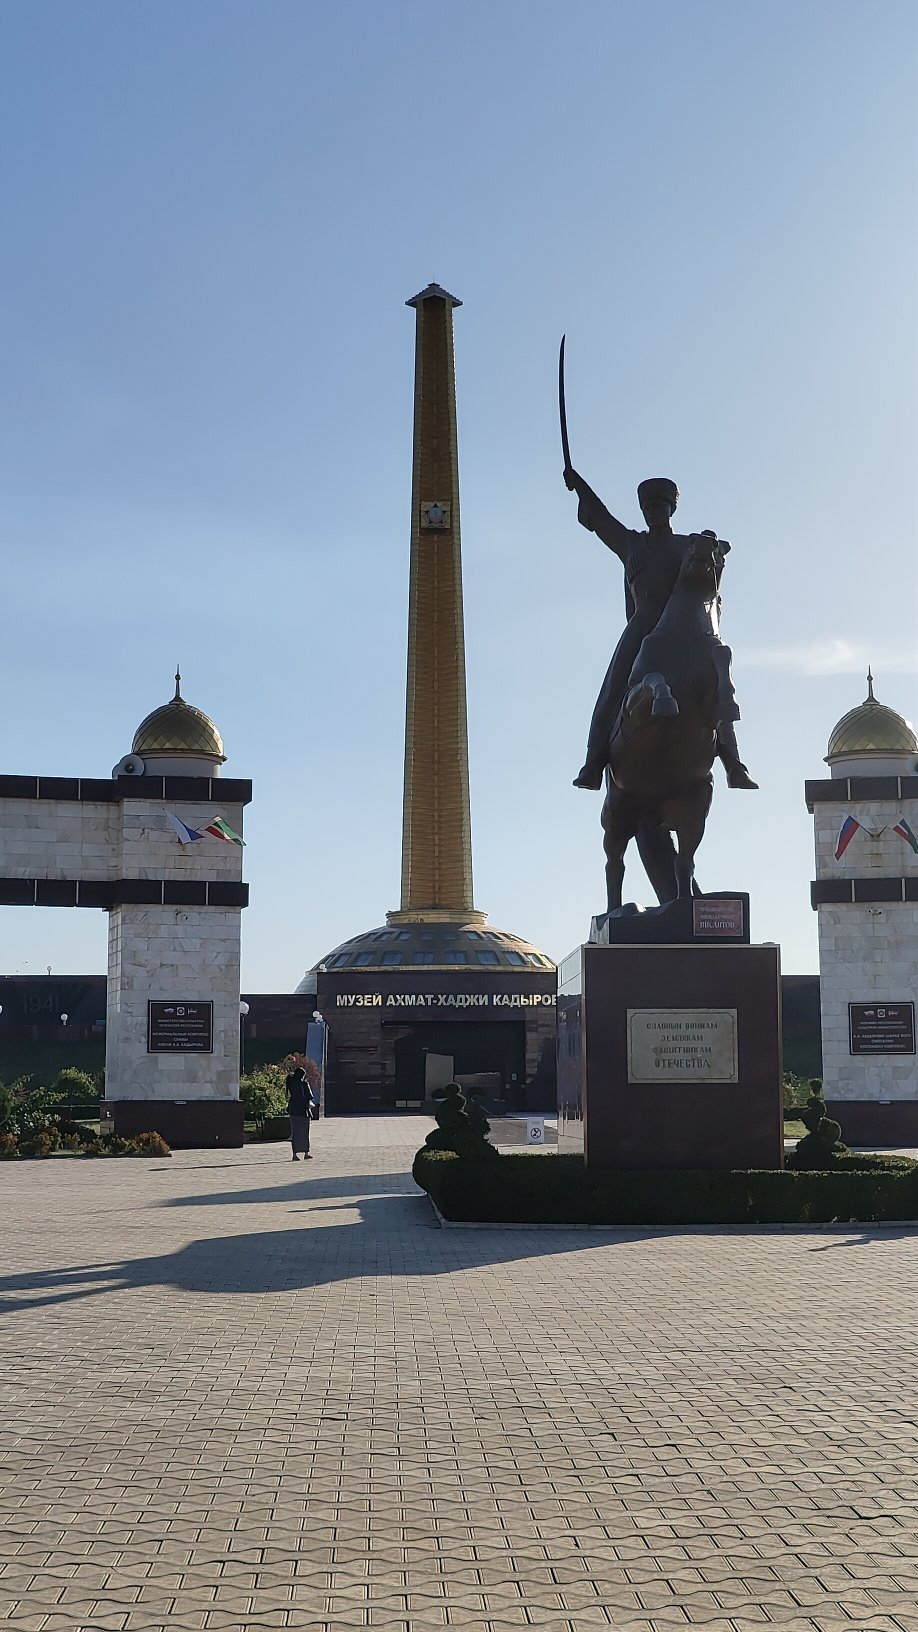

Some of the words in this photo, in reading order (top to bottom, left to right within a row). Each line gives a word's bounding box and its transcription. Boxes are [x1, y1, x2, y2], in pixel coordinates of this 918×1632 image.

[336, 992, 382, 1006] МУЗЕЙ
[386, 994, 489, 1008] АХМАТ-ХАДЖИ
[685, 1022, 718, 1030] ВОИНАМ
[655, 1058, 711, 1069] ОТЕЧЕСТВА
